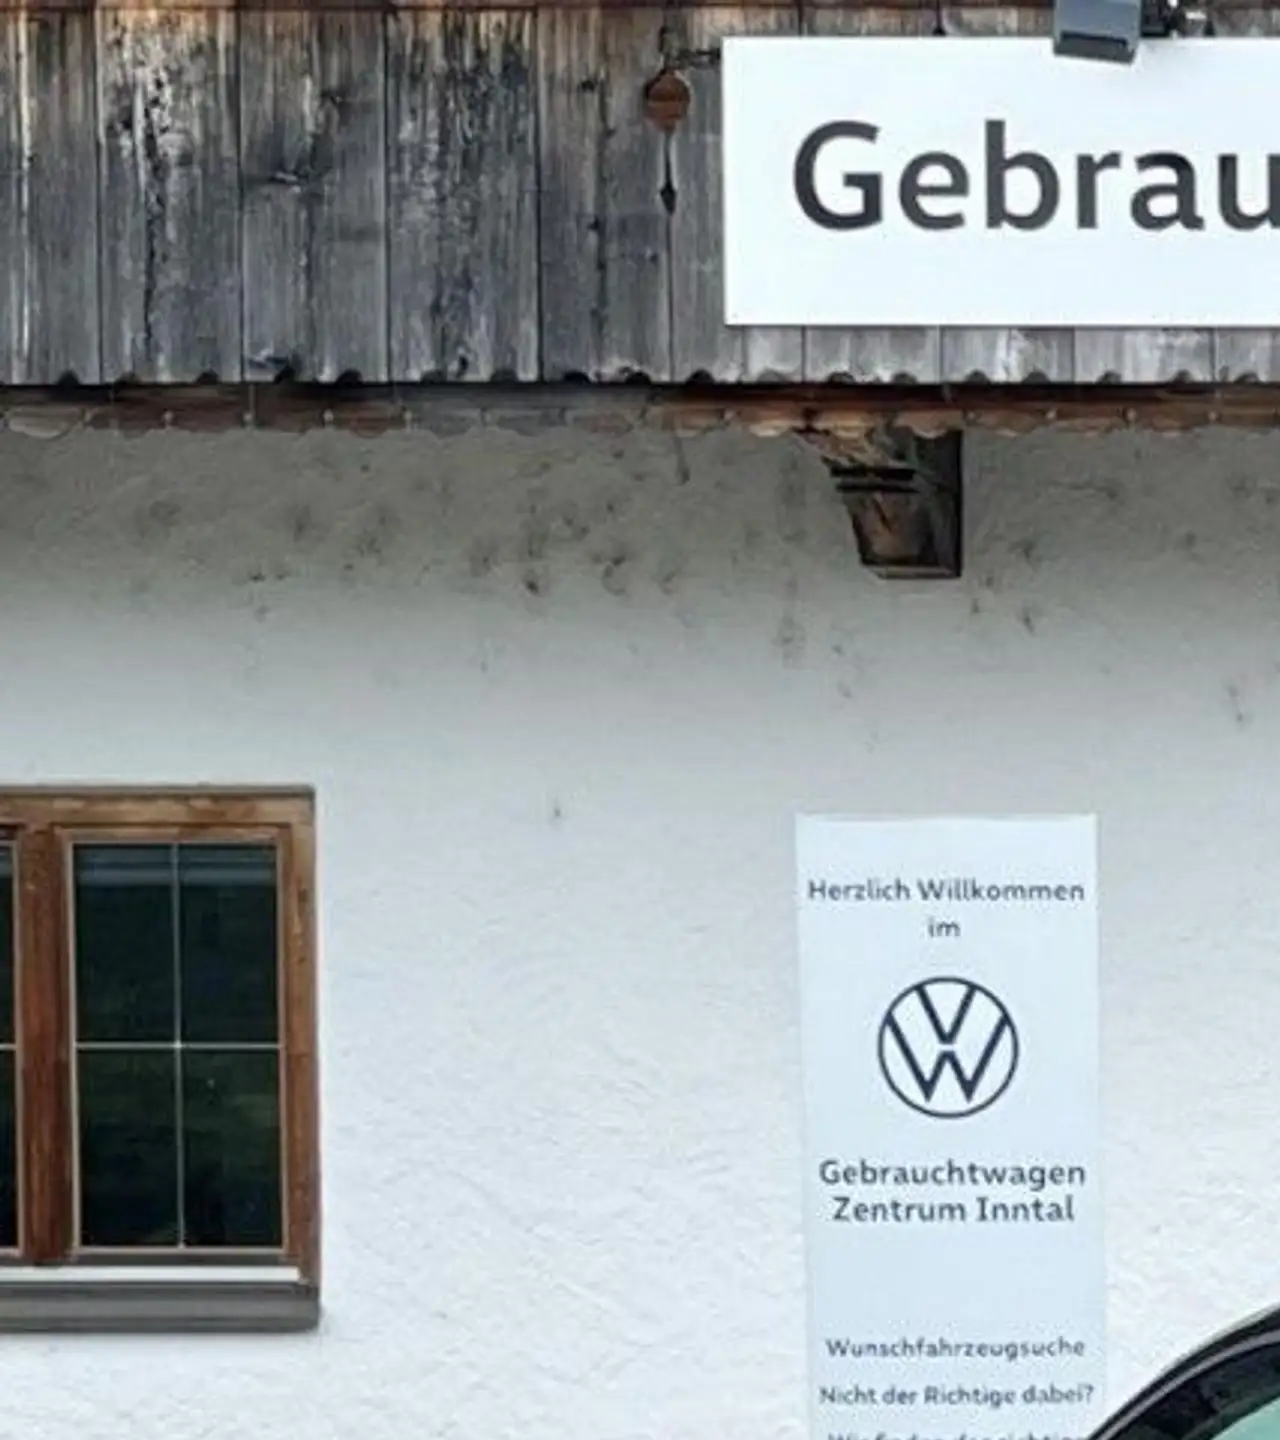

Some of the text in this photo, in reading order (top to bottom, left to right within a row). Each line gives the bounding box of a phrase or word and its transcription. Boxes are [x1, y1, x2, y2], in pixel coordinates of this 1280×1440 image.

[806, 876, 1086, 902] Herzlich Willkommen
[927, 916, 961, 938] im
[818, 1158, 1087, 1193] Gebrauchtwagen
[831, 1194, 1076, 1223] Zentrum Inntal
[825, 1335, 1086, 1363] Wunschfahrzeugsuche
[818, 1382, 1095, 1410] Nicht der Richtige dabei?
